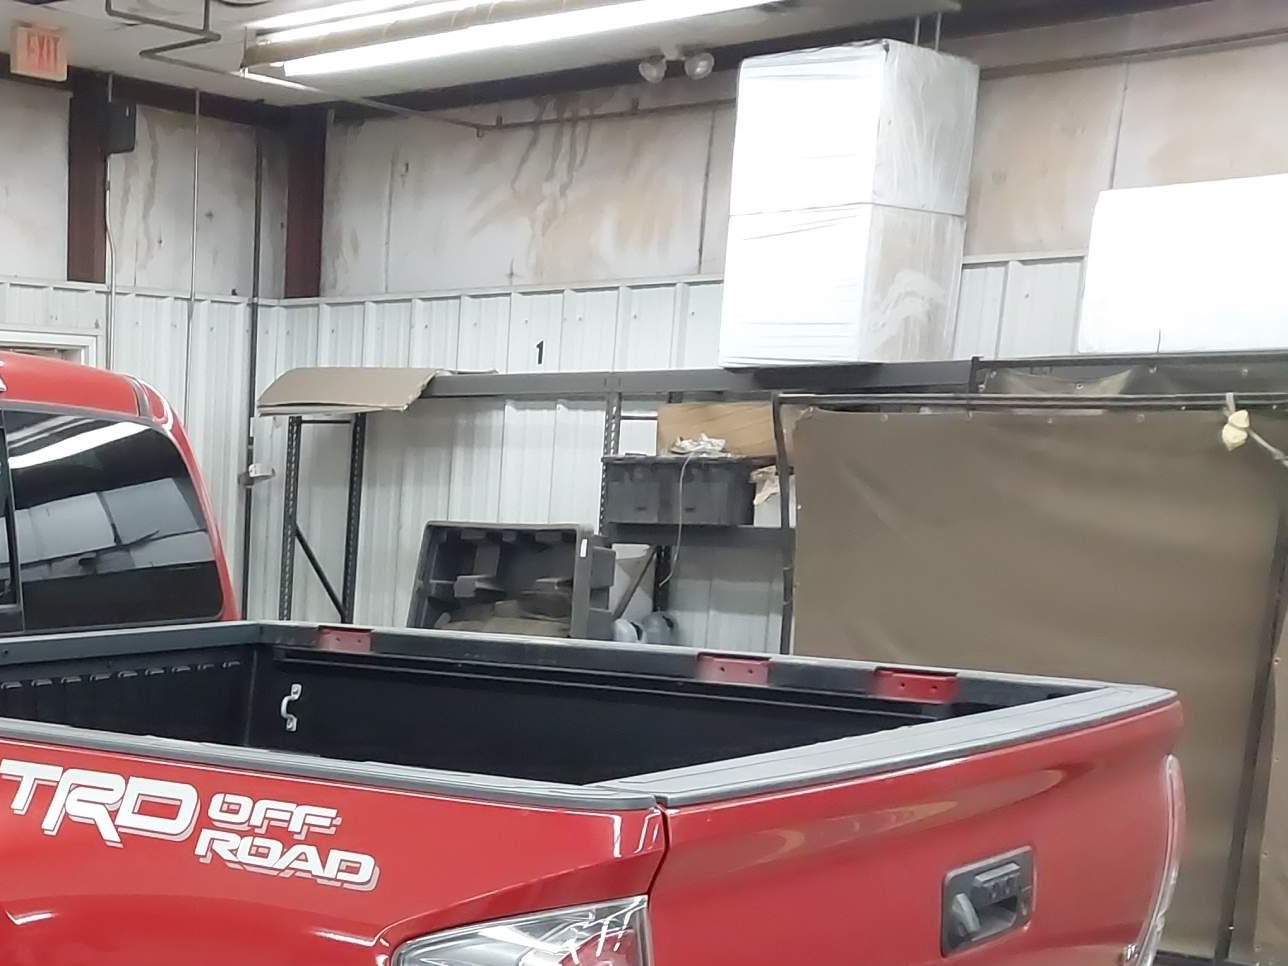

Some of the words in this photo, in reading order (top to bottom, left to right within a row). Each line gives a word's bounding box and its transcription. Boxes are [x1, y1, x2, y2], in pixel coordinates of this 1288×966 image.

[25, 32, 61, 74] EXIT
[536, 340, 544, 365] 1
[207, 792, 343, 840] OFF
[194, 828, 380, 892] ROAD
